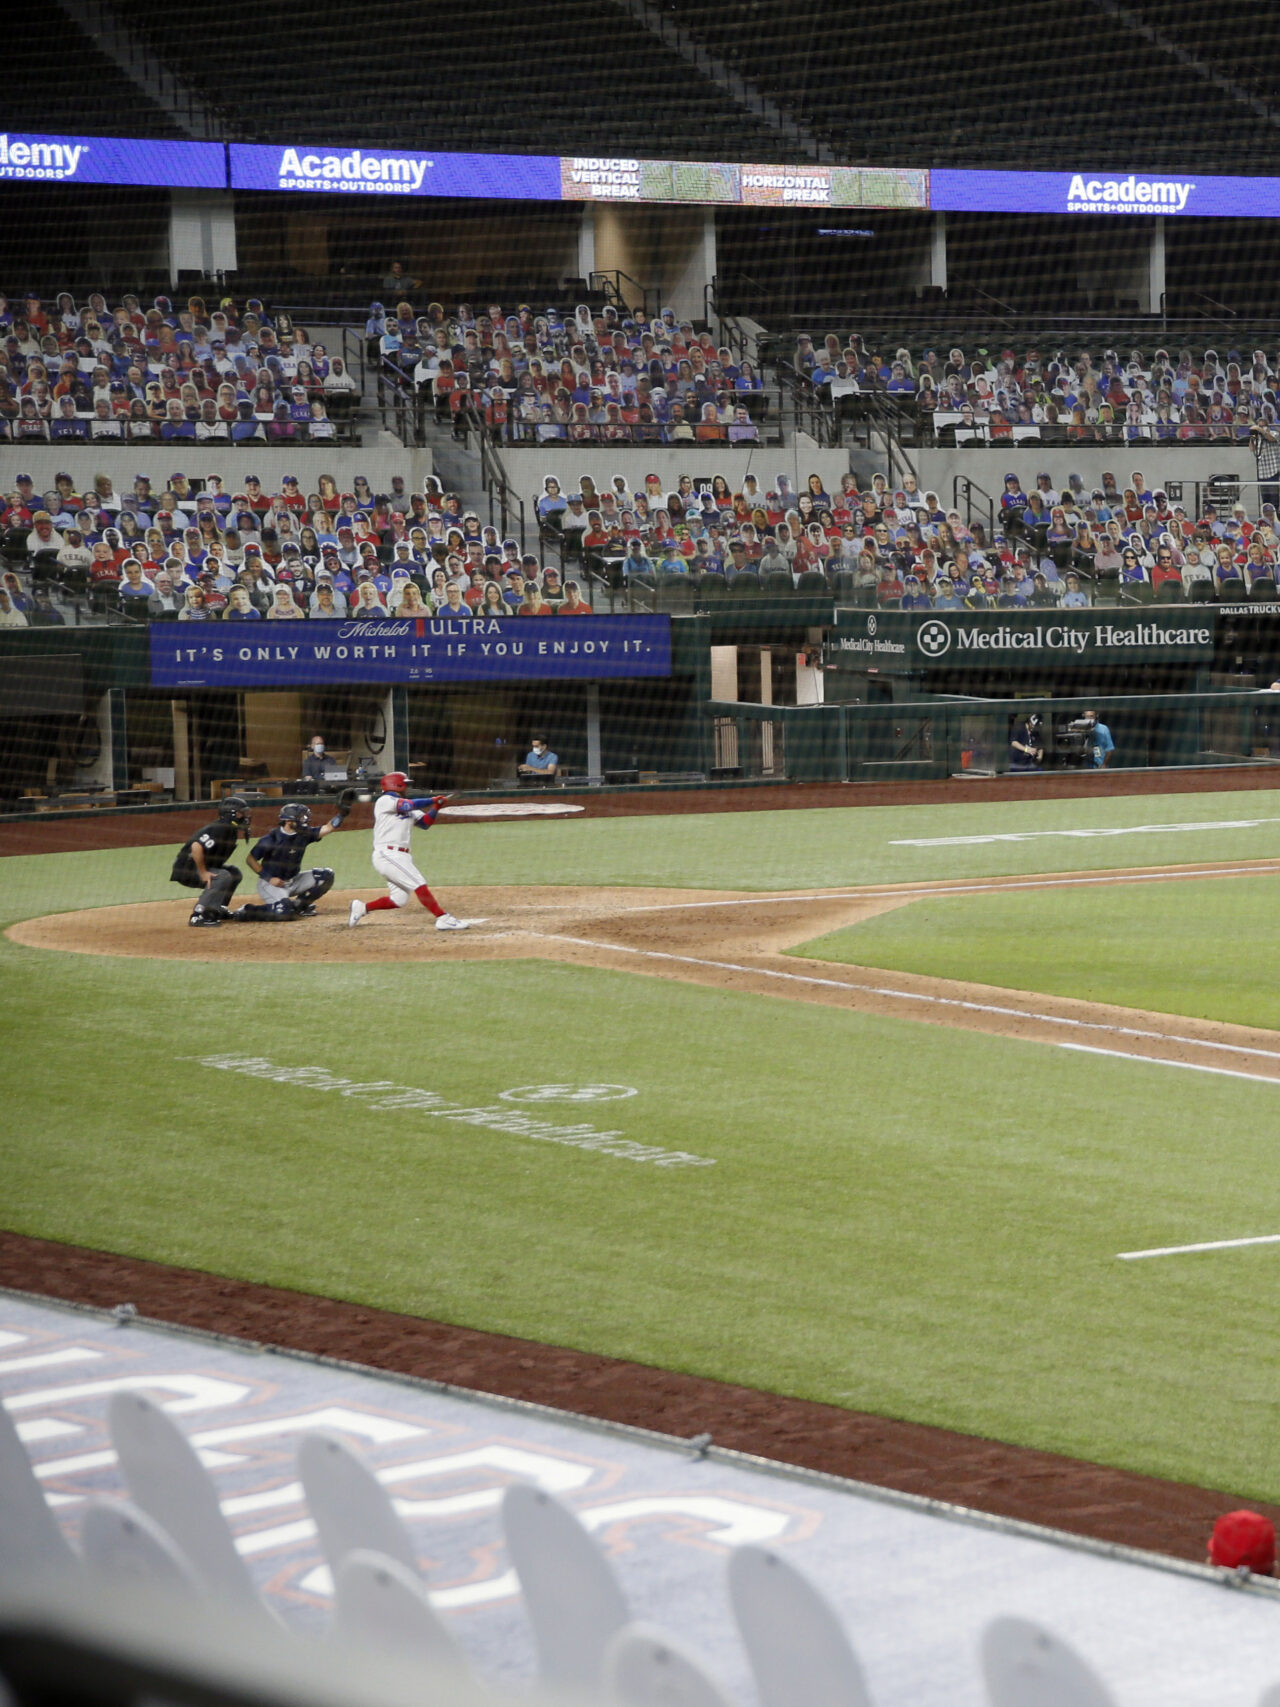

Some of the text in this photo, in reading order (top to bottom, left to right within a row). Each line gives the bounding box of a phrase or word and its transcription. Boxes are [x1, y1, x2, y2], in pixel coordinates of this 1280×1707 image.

[279, 148, 427, 189] Academy
[574, 159, 639, 172] INDUCED
[571, 171, 639, 185] VERTICAL
[743, 176, 829, 189] HORIZONTAL
[592, 185, 639, 198] BREAK
[783, 188, 829, 201] BREAK
[1067, 175, 1190, 210] Academy
[64, 554, 88, 563] TEXAS
[1220, 606, 1248, 615] DALLAS
[1248, 605, 1277, 614] TRUCK
[338, 618, 502, 639] Michelob ULTRA
[957, 624, 1209, 652] Medical City Healthcare
[239, 647, 299, 660] ONLY
[315, 646, 396, 660] WORTH
[412, 645, 431, 657] IT
[448, 644, 466, 656] IF
[482, 643, 524, 655] YOU
[538, 641, 609, 654] ENJOY
[624, 640, 652, 653] IT.
[840, 638, 905, 655] Medical City Healthcare
[199, 833, 215, 849] 30
